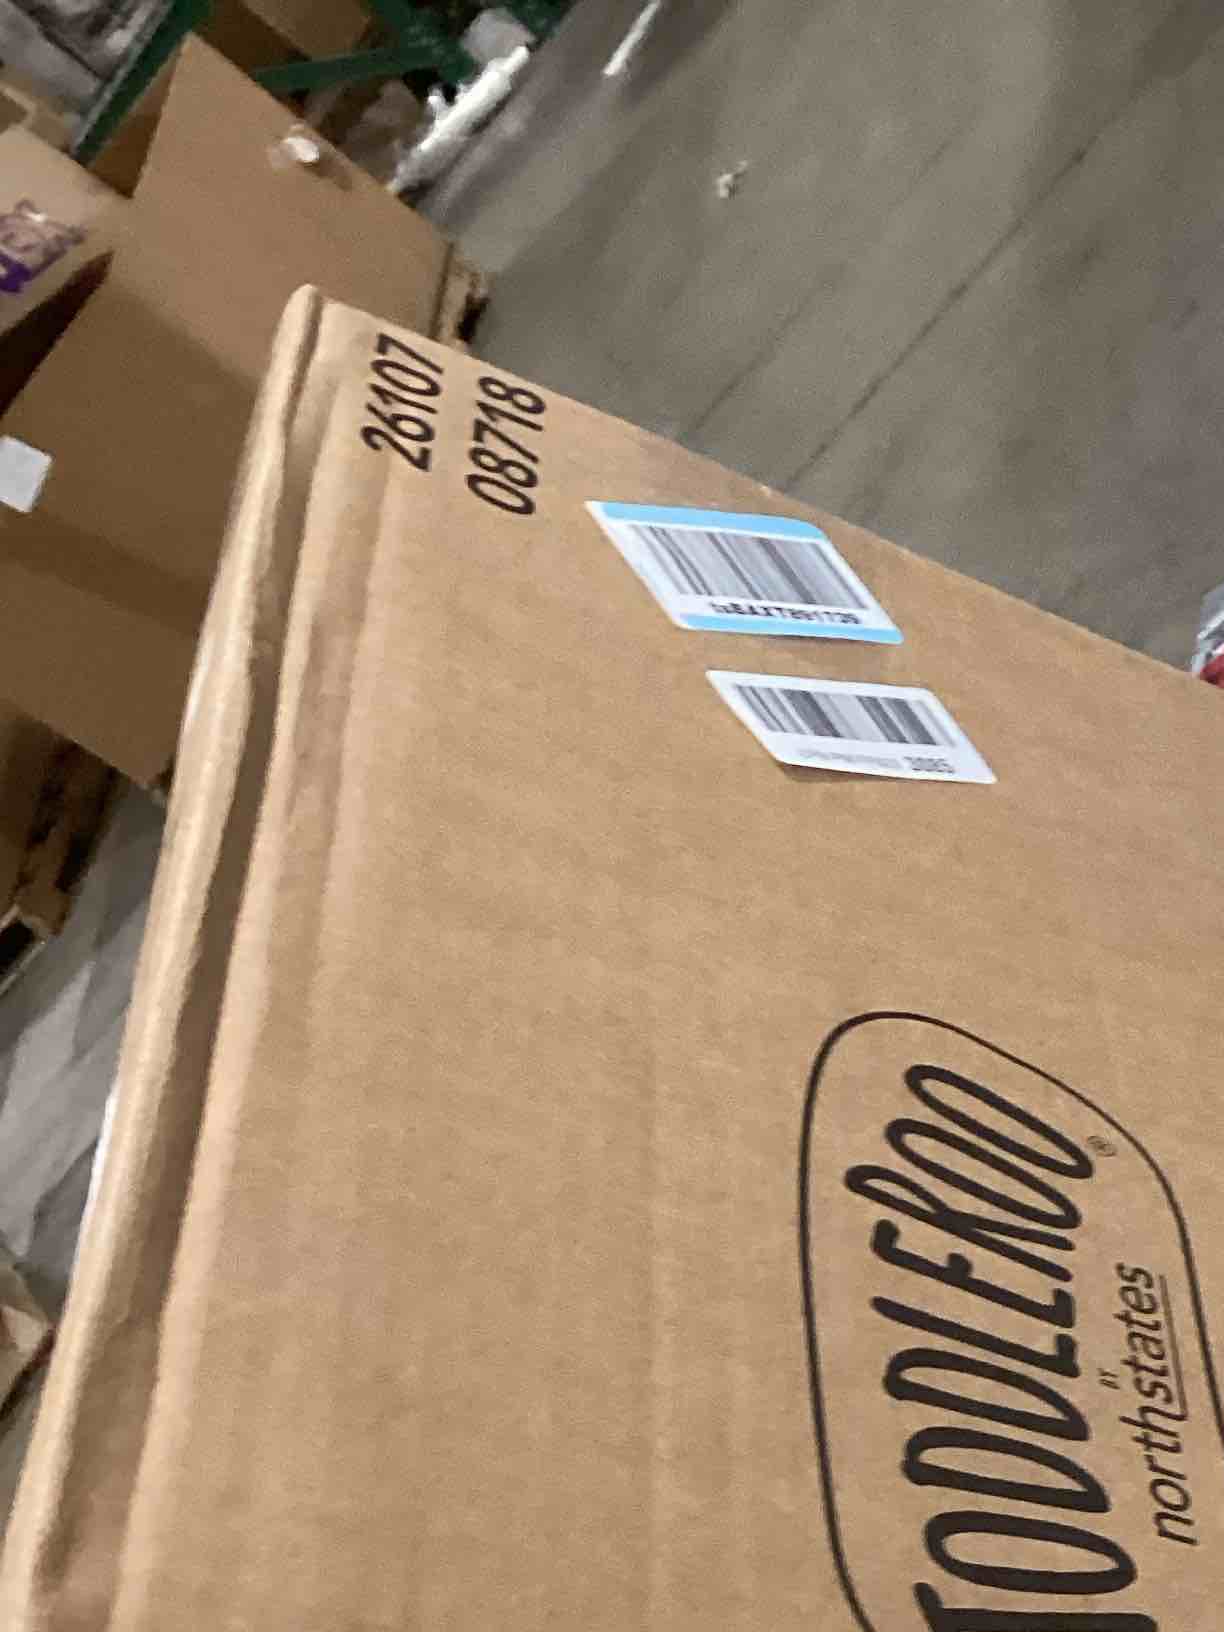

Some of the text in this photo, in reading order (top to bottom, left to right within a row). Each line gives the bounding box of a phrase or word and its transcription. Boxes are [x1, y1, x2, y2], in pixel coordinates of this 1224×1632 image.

[360, 333, 444, 472] 26107
[465, 376, 546, 515] 08718
[1118, 1262, 1199, 1547] northstates
